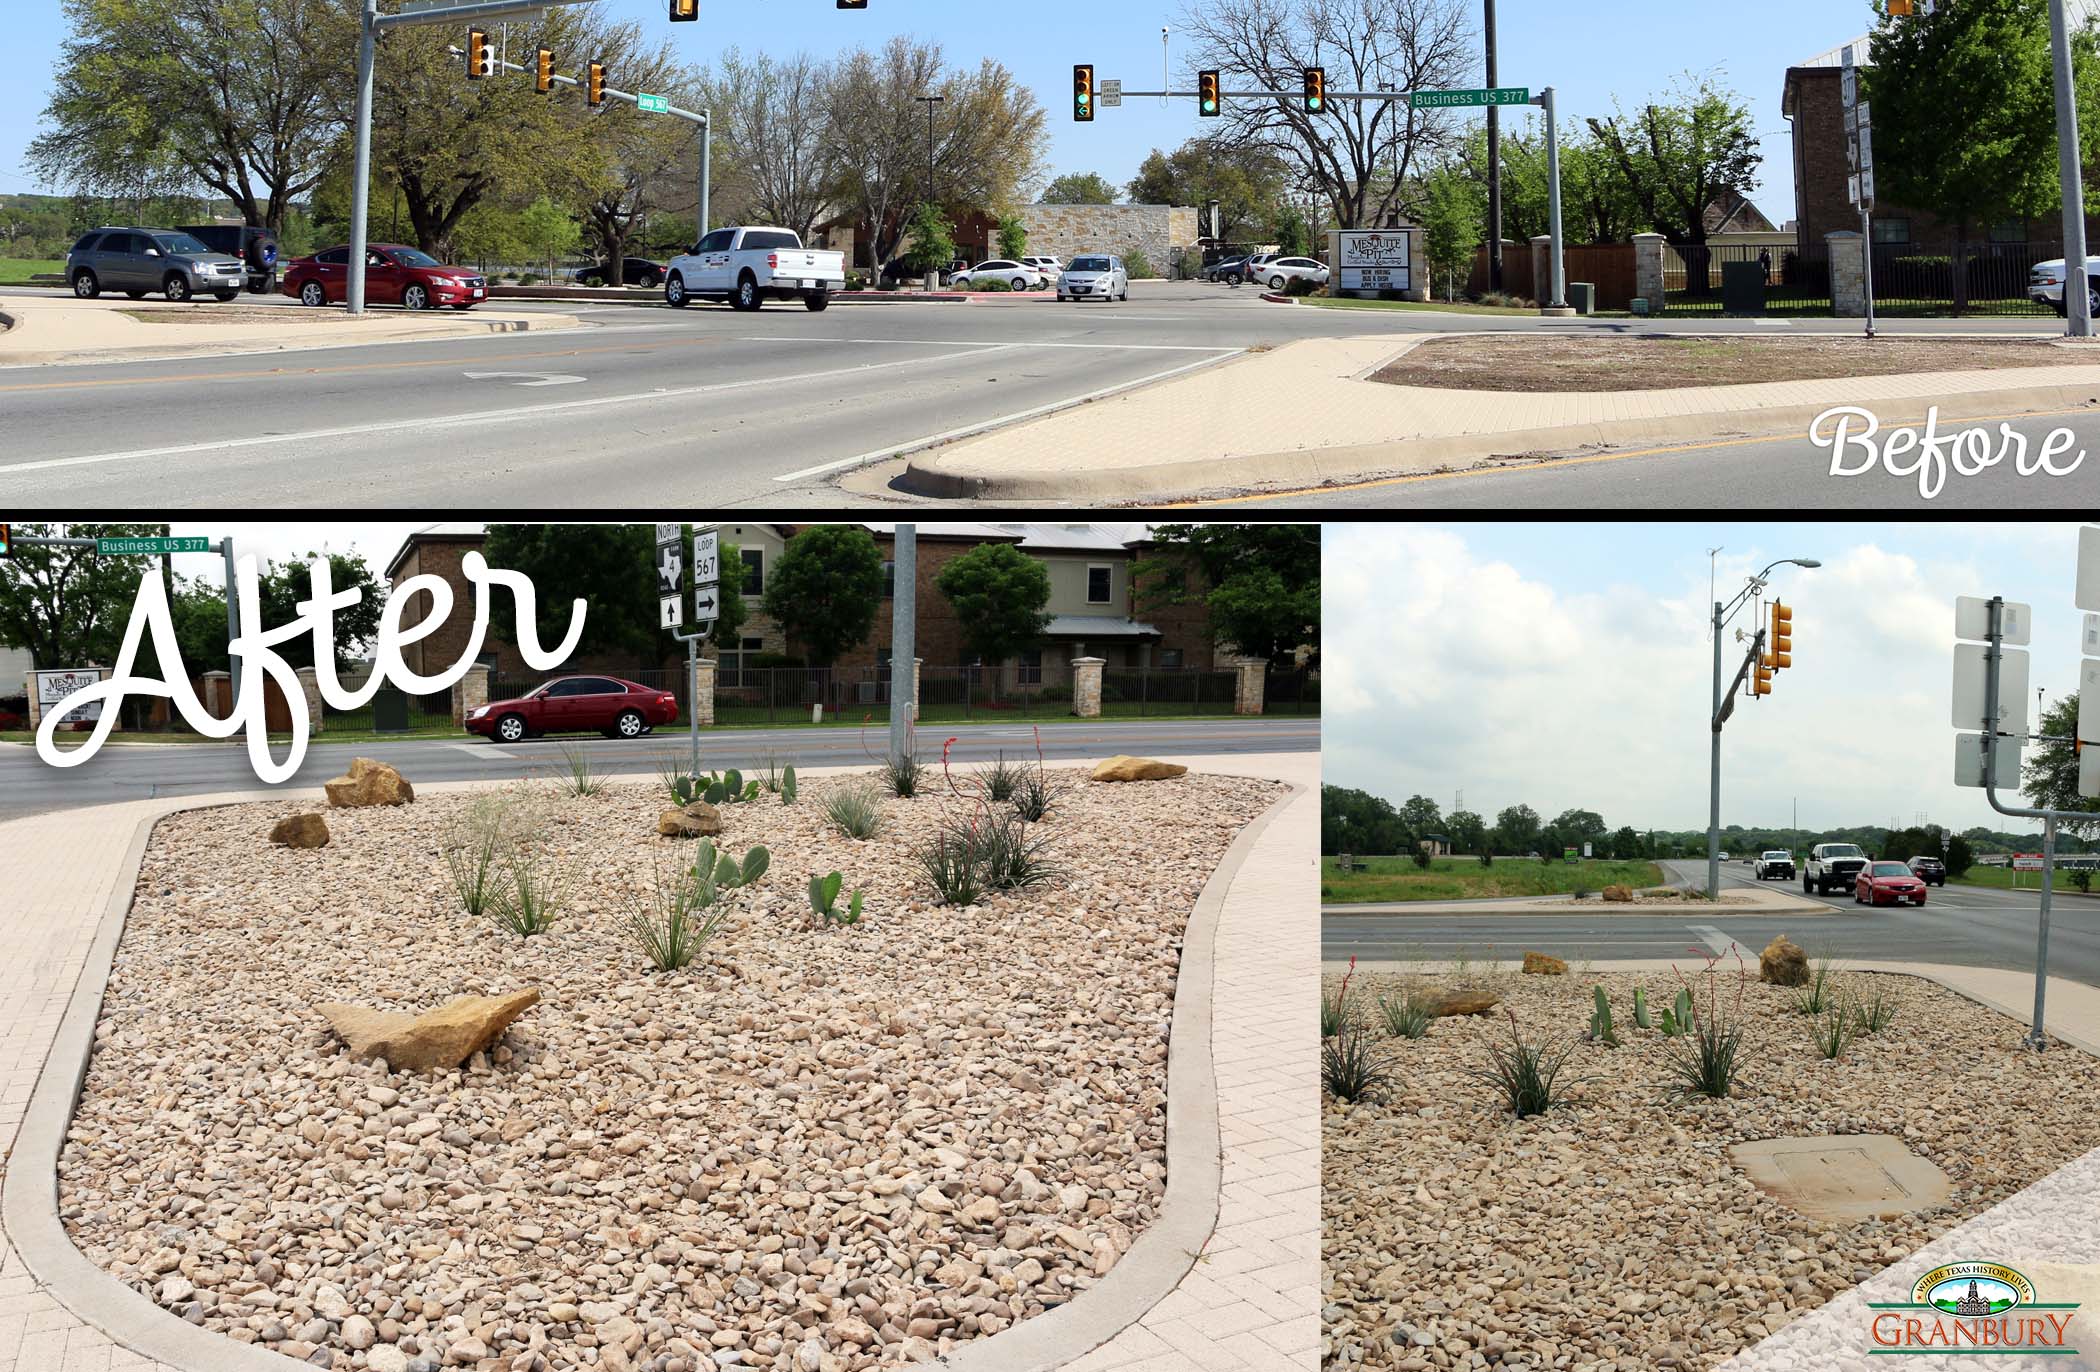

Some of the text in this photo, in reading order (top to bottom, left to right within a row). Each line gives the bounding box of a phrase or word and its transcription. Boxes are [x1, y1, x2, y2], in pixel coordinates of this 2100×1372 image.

[1415, 91, 1524, 105] Business US 377
[1350, 239, 1401, 254] MESQUITE
[1365, 248, 1384, 260] PIT
[657, 523, 679, 539] NORTH
[102, 539, 205, 552] Business US 377
[697, 538, 713, 551] LOOP
[669, 559, 674, 573] 4
[696, 556, 715, 576] 567
